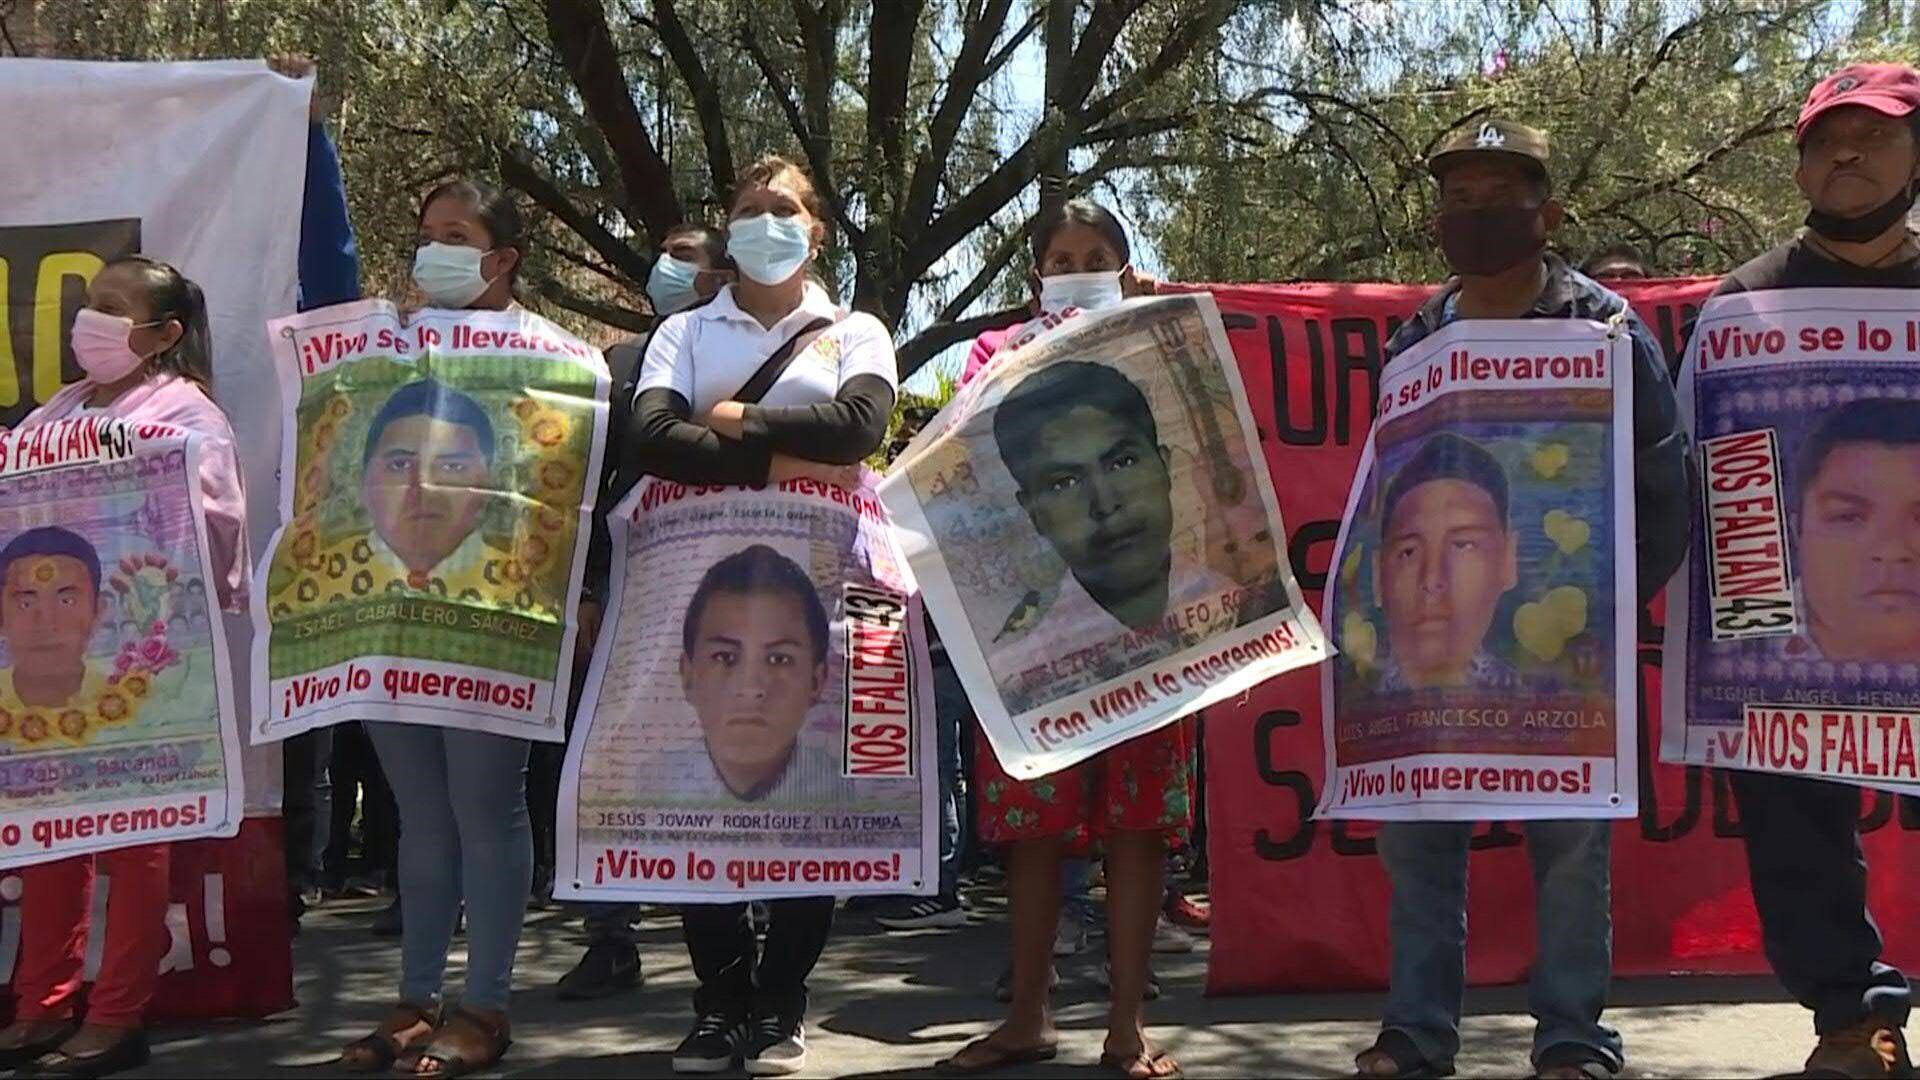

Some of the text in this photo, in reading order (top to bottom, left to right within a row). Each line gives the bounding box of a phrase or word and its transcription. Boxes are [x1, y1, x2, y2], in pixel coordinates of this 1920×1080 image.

[1476, 121, 1504, 148] LA
[303, 333, 368, 374] ¡Vivo
[376, 328, 410, 354] se
[418, 325, 441, 349] lo
[1700, 326, 1786, 369] ¡Vivo
[1799, 326, 1844, 351] se
[1858, 320, 1891, 352] lo
[1399, 380, 1422, 407] se
[1427, 361, 1442, 393] lo
[1450, 349, 1604, 380] llevaron!
[16, 418, 100, 471] FALTAN
[1708, 432, 1794, 640] NOS FALTAN 43!
[355, 603, 457, 626] CABALLERO
[284, 664, 536, 718] ¡Vivo lo queremos!
[852, 622, 907, 715] FALTAN
[1030, 714, 1093, 752] ¡Con
[1090, 680, 1158, 725] VIDA
[1182, 620, 1300, 688] queremos!
[1700, 685, 1765, 701] MIGUEL
[1407, 708, 1509, 729] FRANCISCO
[1522, 711, 1607, 729] ARZOLA
[1746, 711, 1809, 771] NOS
[851, 723, 908, 776] NOS
[1341, 762, 1591, 805] ¡Vivo lo queremos!
[32, 796, 208, 848] queremos!
[597, 811, 902, 831] JESÚS JOVANY RODRÍGUEZ TLATEMPA
[595, 848, 900, 889] ¡Vivo lo queremos!
